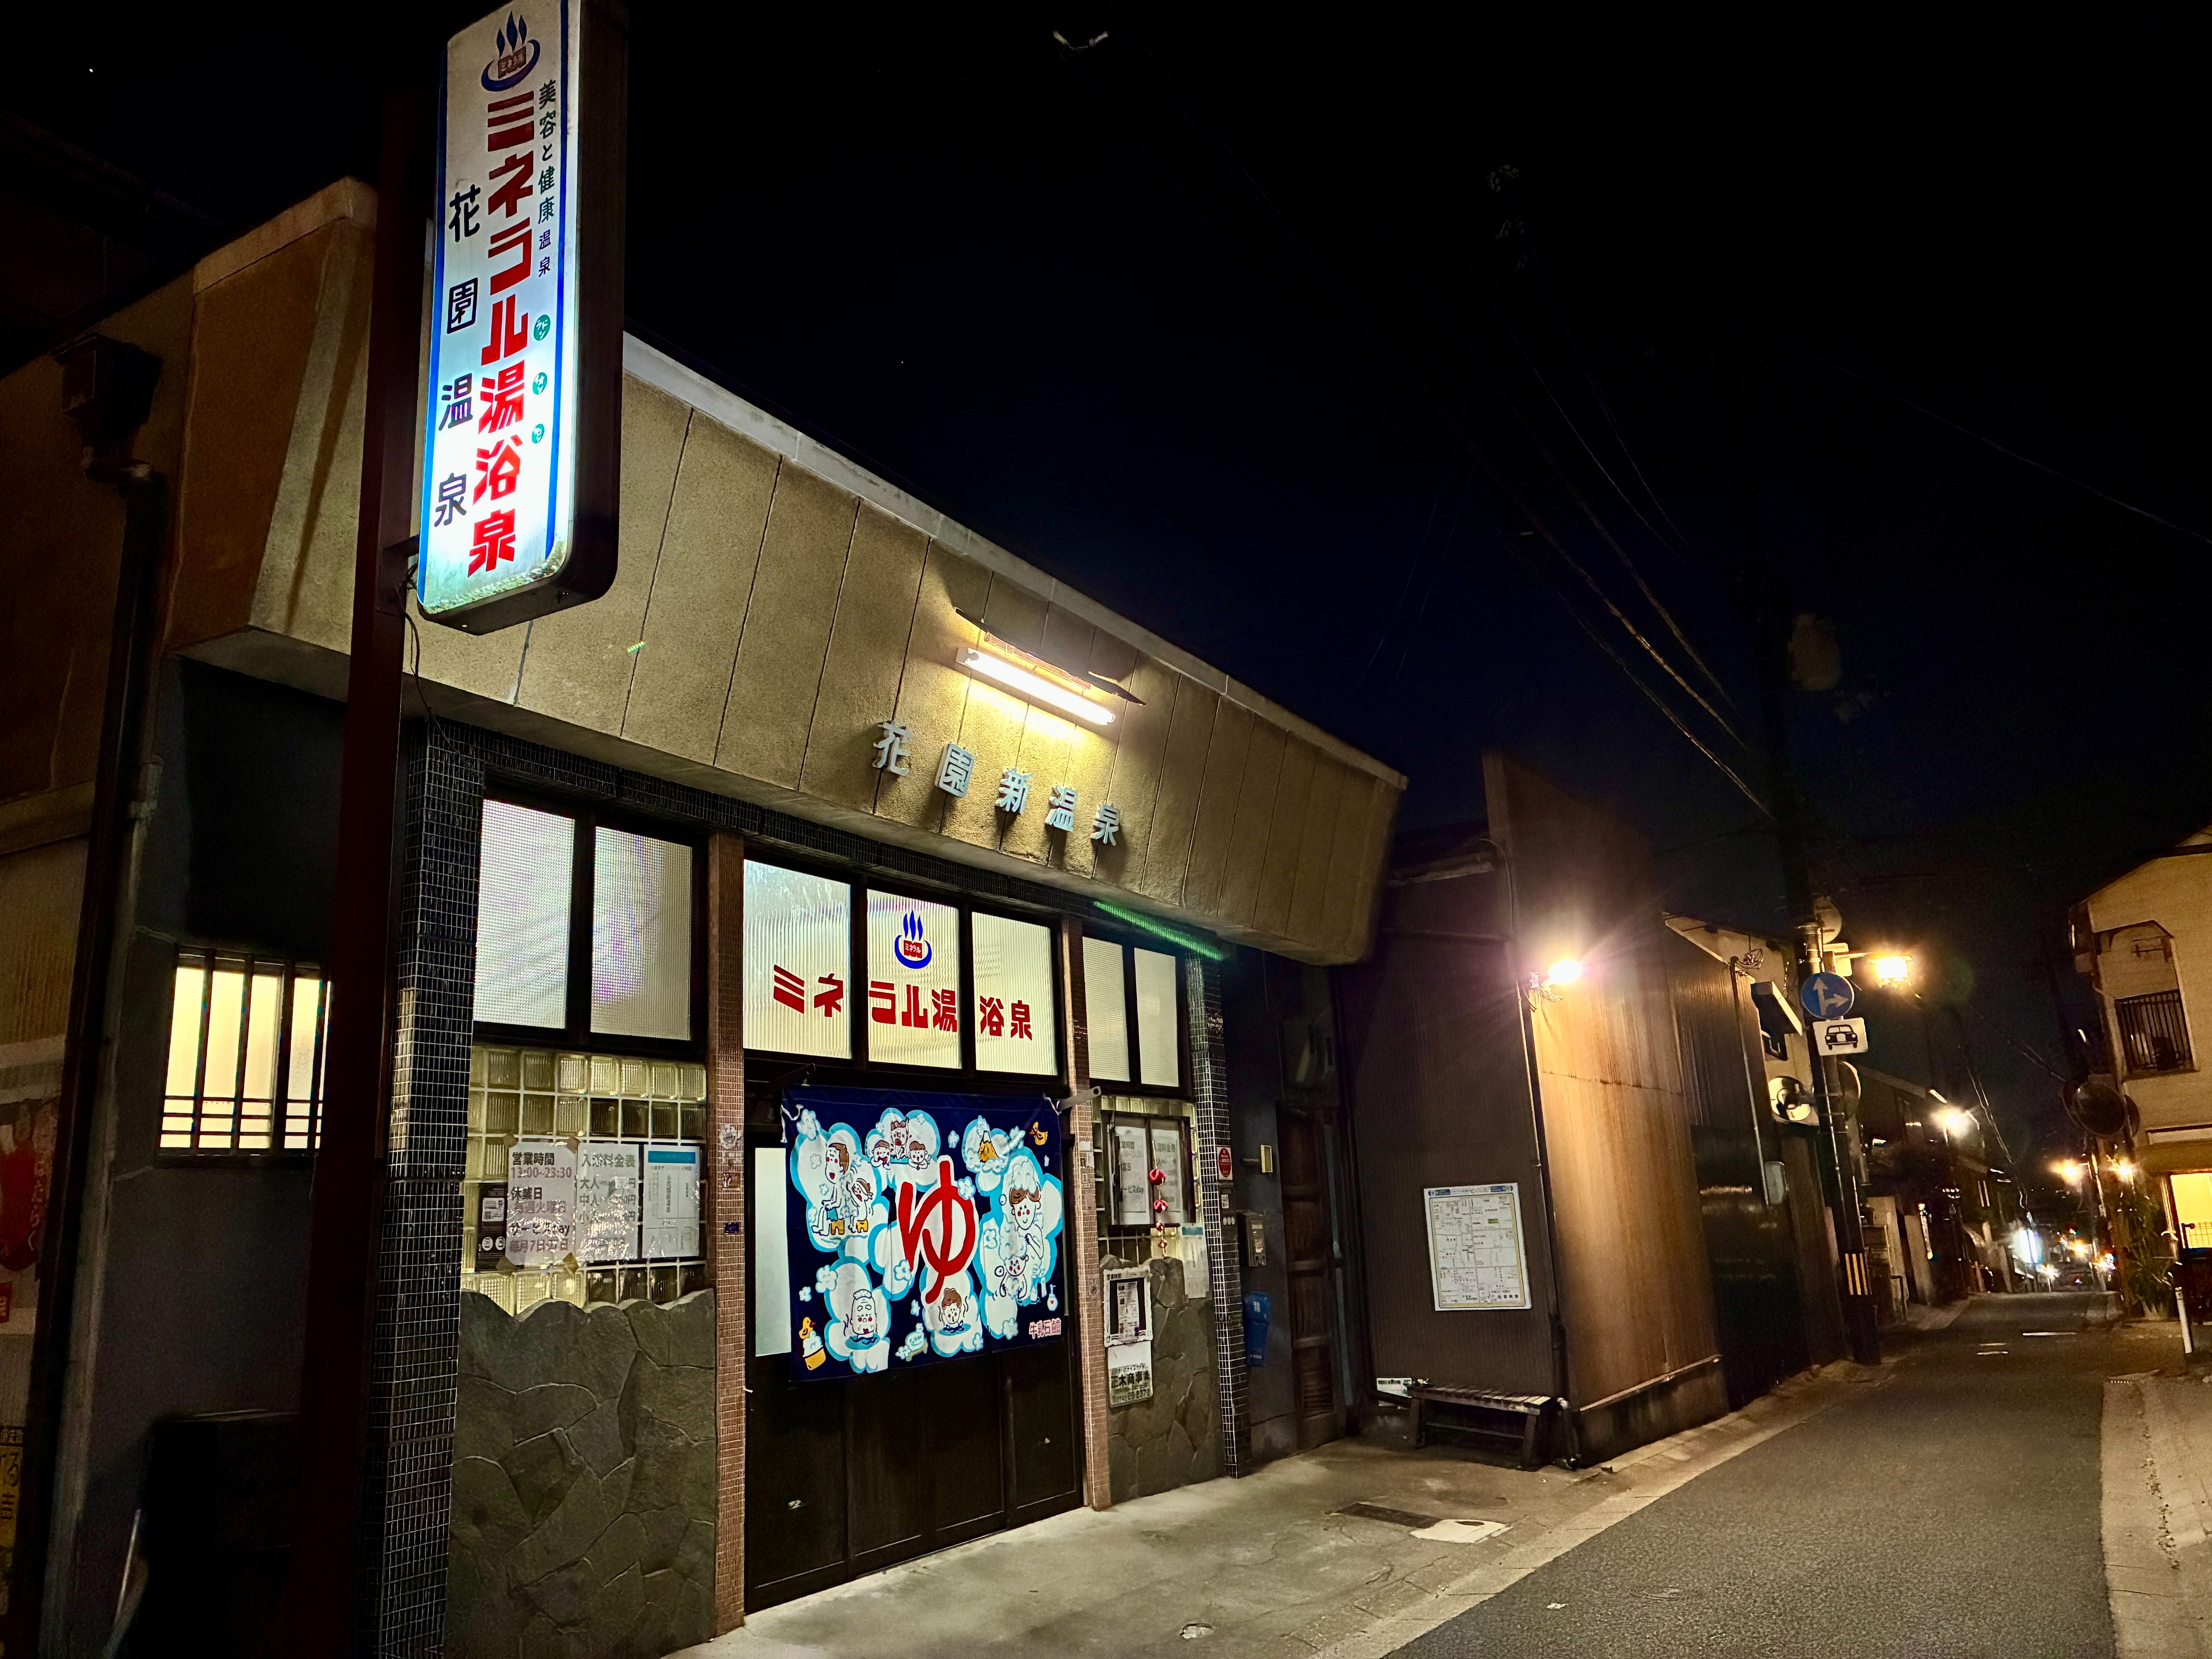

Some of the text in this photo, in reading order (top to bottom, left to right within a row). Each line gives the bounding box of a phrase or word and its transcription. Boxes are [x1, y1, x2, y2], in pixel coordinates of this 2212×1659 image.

[434, 184, 481, 527] 花園温泉
[467, 90, 534, 578] ミネラル湯浴泉
[872, 720, 1120, 845] 花園新温泉
[905, 943, 921, 954] ミネラル
[773, 964, 1032, 1041] ミネラル湯浴泉
[511, 1186, 542, 1200] 休業日
[512, 1152, 555, 1165] 営業時間
[897, 1160, 975, 1304] ゆ
